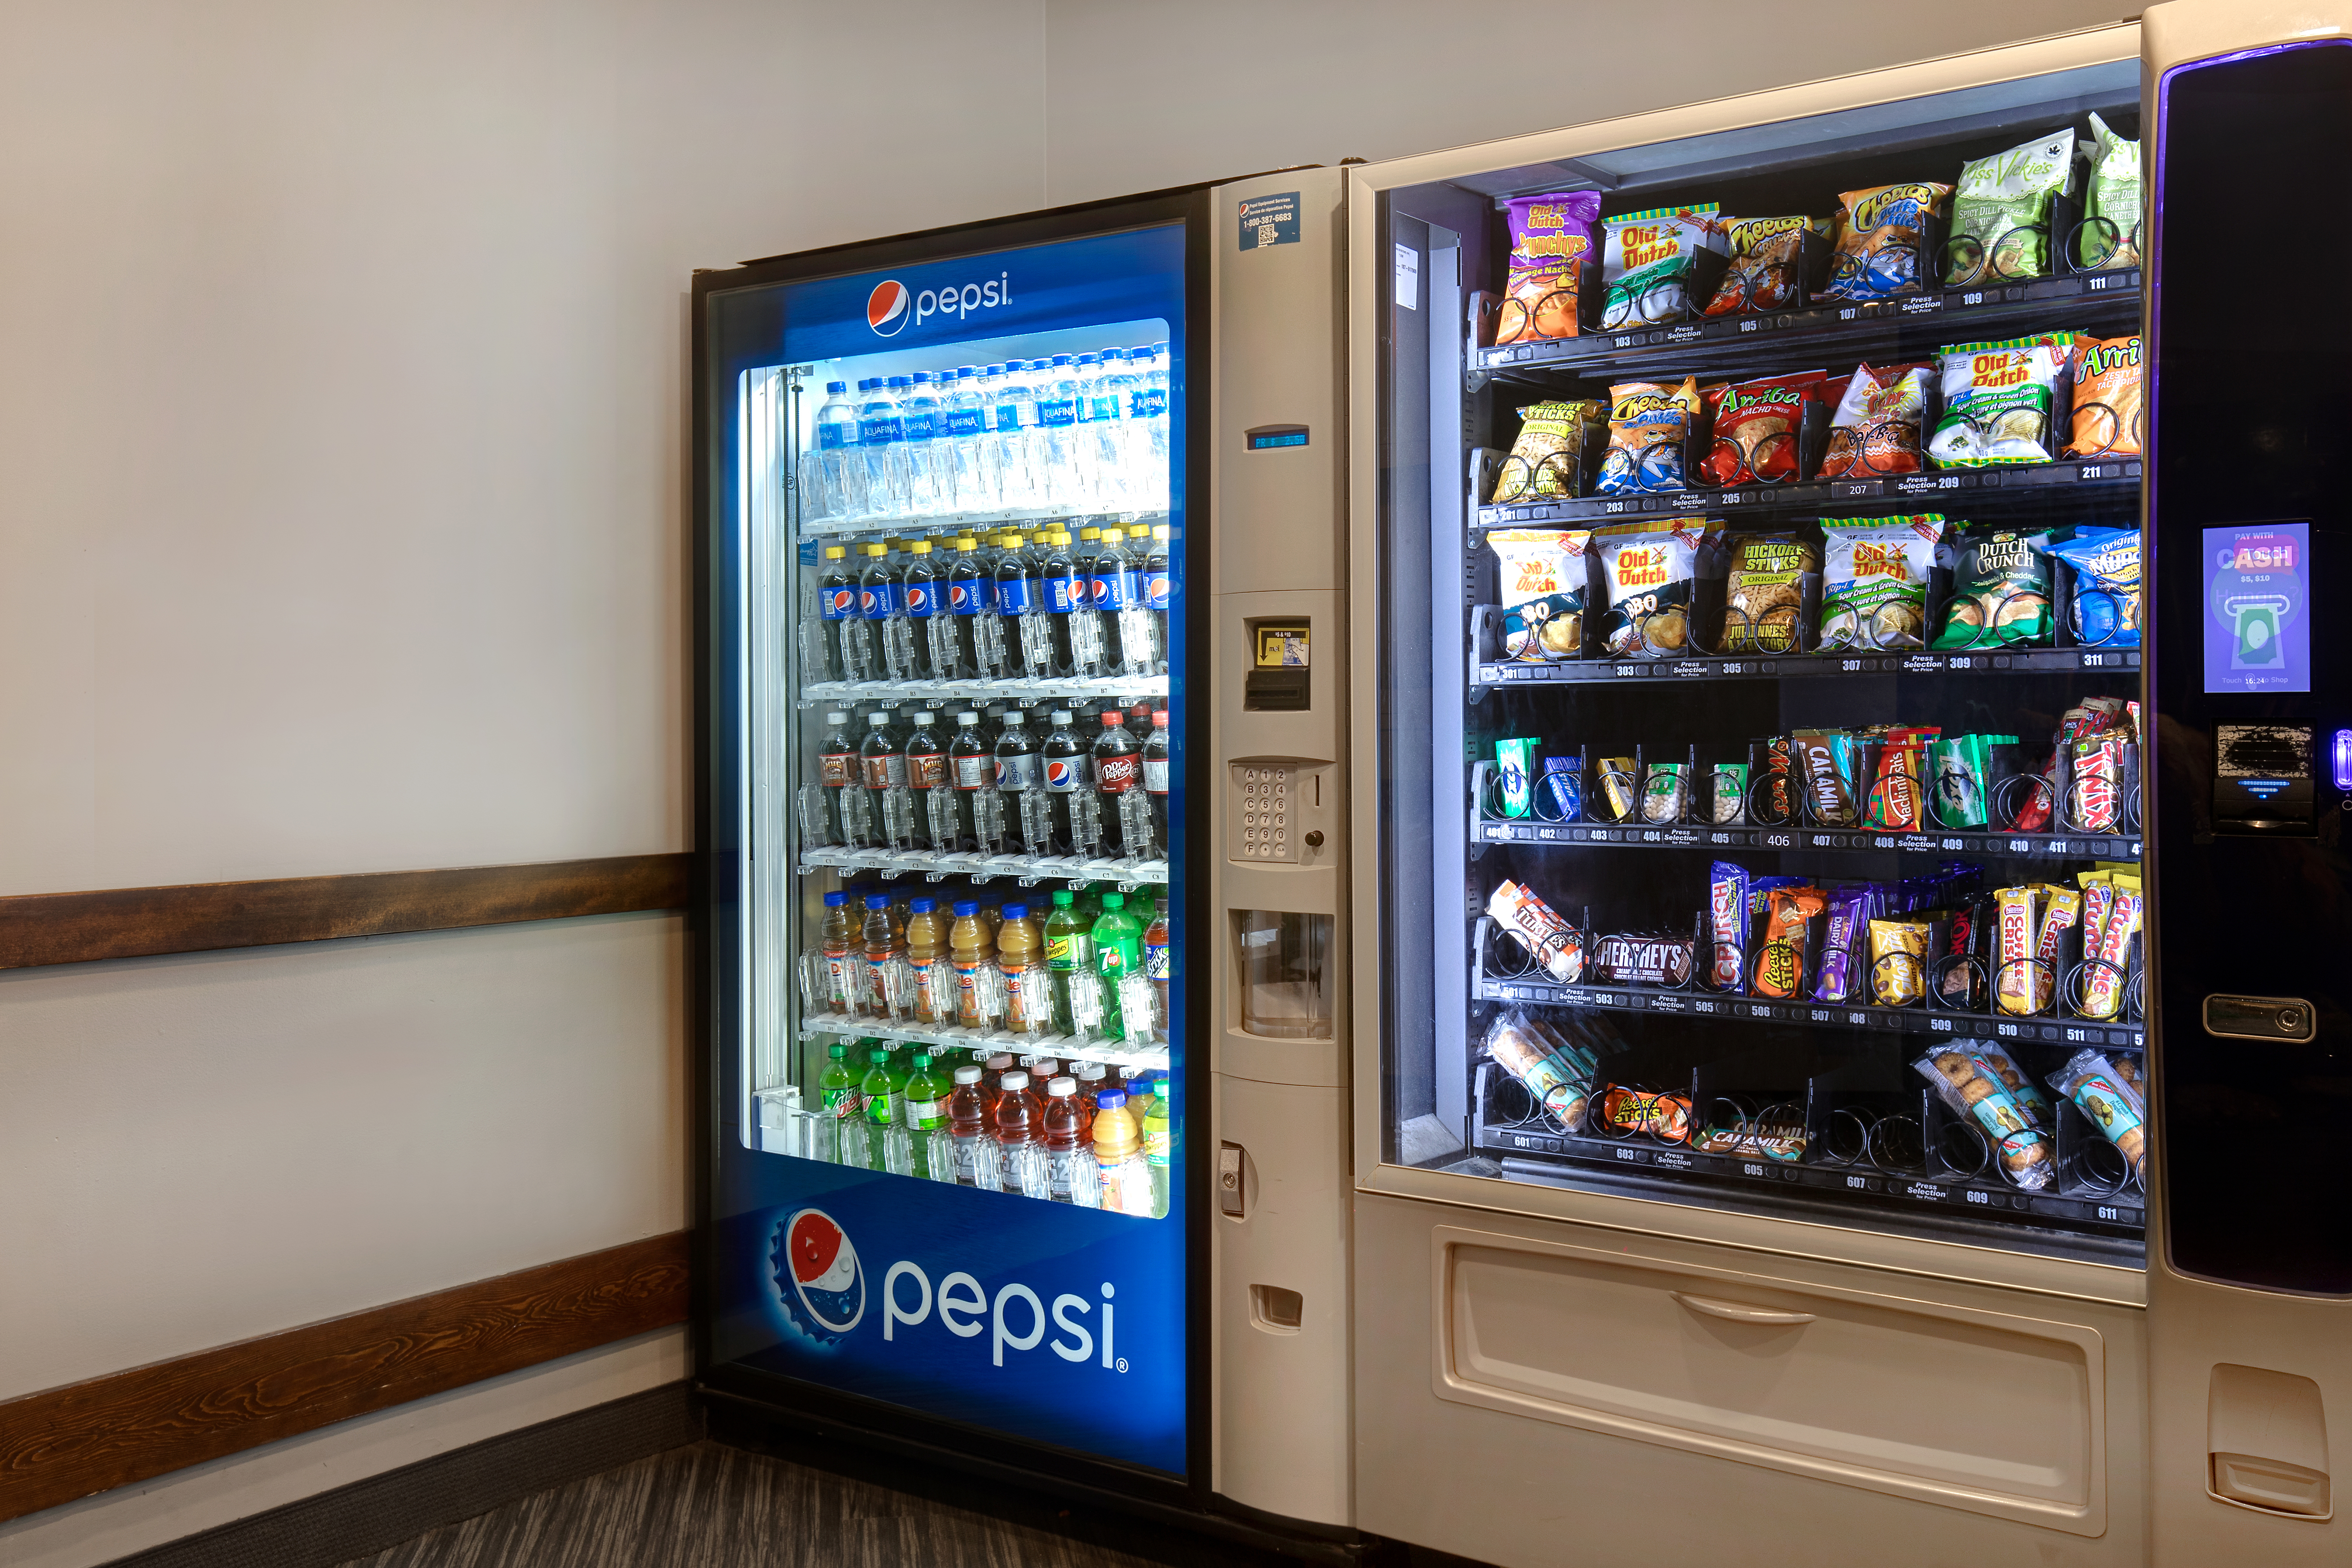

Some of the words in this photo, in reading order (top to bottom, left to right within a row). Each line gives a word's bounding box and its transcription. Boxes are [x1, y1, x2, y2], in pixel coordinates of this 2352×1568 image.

[1997, 151, 2053, 187] Vickie's
[1855, 184, 1931, 233] Cheetos
[1244, 213, 1292, 228] 1-800-387-6683
[1622, 226, 1658, 246] Old
[1731, 216, 1805, 256] Cheetos
[1623, 241, 1678, 270] Dutch
[2090, 277, 2106, 289] 111
[917, 271, 1008, 325] pepsi
[1963, 292, 1982, 305] 109
[1740, 321, 1756, 331] 105
[1615, 337, 1630, 346] 103
[1973, 352, 2008, 373] Old
[1972, 366, 2031, 387] Dutch
[2104, 369, 2131, 381] ZESTY
[1716, 387, 1800, 420] Arriba
[1740, 406, 1772, 417] NACHO
[865, 424, 899, 437] AQUAFINA
[1526, 424, 1563, 433] ORIGINAL
[2083, 466, 2101, 478] 211
[1939, 477, 1958, 488] 209
[1850, 486, 1866, 494] 207
[1607, 502, 1623, 512] 203
[1980, 538, 2029, 557] DUTCH
[2244, 547, 2288, 560] Touch
[1619, 552, 1648, 568] Old
[1977, 551, 2035, 575] CRUNCH
[2216, 545, 2292, 569] CASH
[1745, 557, 1799, 571] STICKS
[1619, 568, 1666, 586] Dutch
[1855, 562, 1906, 580] Dutch
[2005, 571, 2035, 580] Cheddar
[1748, 574, 1788, 583] ORIGINAL
[970, 585, 980, 606] pepsi
[1110, 580, 1120, 602] pepsi
[1853, 587, 1873, 597] Cream
[1879, 582, 1897, 590] Green
[1878, 592, 1900, 602] oignon
[1843, 660, 1860, 671] 307
[1950, 657, 1971, 668] 309
[2085, 654, 2102, 665] 311
[1723, 663, 1741, 674] 305
[825, 761, 842, 769] MUG
[1102, 763, 1130, 780] Pepper
[1111, 761, 1122, 771] Dr
[1009, 761, 1018, 784] pepsi
[1073, 761, 1082, 784] pepsi
[1808, 746, 1842, 822] CARAMILK
[1939, 755, 1964, 811] excel
[1550, 777, 1563, 805] HALLS
[1605, 779, 1618, 805] HALLS
[1540, 830, 1555, 839] 402
[1591, 831, 1607, 840] 403
[1712, 833, 1729, 843] 405
[1768, 836, 1790, 846] 406
[1875, 837, 1894, 847] 408
[1897, 840, 1936, 848] Selection
[1942, 839, 1962, 850] 409
[2049, 842, 2066, 853] 411
[1515, 906, 1566, 949] TURTLES
[1713, 882, 1735, 982] CRUNCH
[2004, 916, 2015, 968] CRISP
[2014, 916, 2025, 980] COFFEE
[1099, 946, 1112, 971] 7
[1109, 955, 1118, 965] up
[1503, 987, 1518, 997] 501
[1696, 1001, 1713, 1012] 505
[1812, 1010, 1829, 1021] 507
[1998, 1024, 2017, 1036] 510
[2067, 1029, 2084, 1041] 511
[1617, 1096, 1658, 1110] Reese's
[1614, 1108, 1662, 1123] STICKS
[1514, 1136, 1530, 1147] 601
[1712, 1132, 1795, 1148] CARAMILK
[1617, 1149, 1634, 1160] 603
[1847, 1176, 1865, 1188] 607
[2098, 1207, 2116, 1219] 611
[884, 1260, 1115, 1369] pepsi
